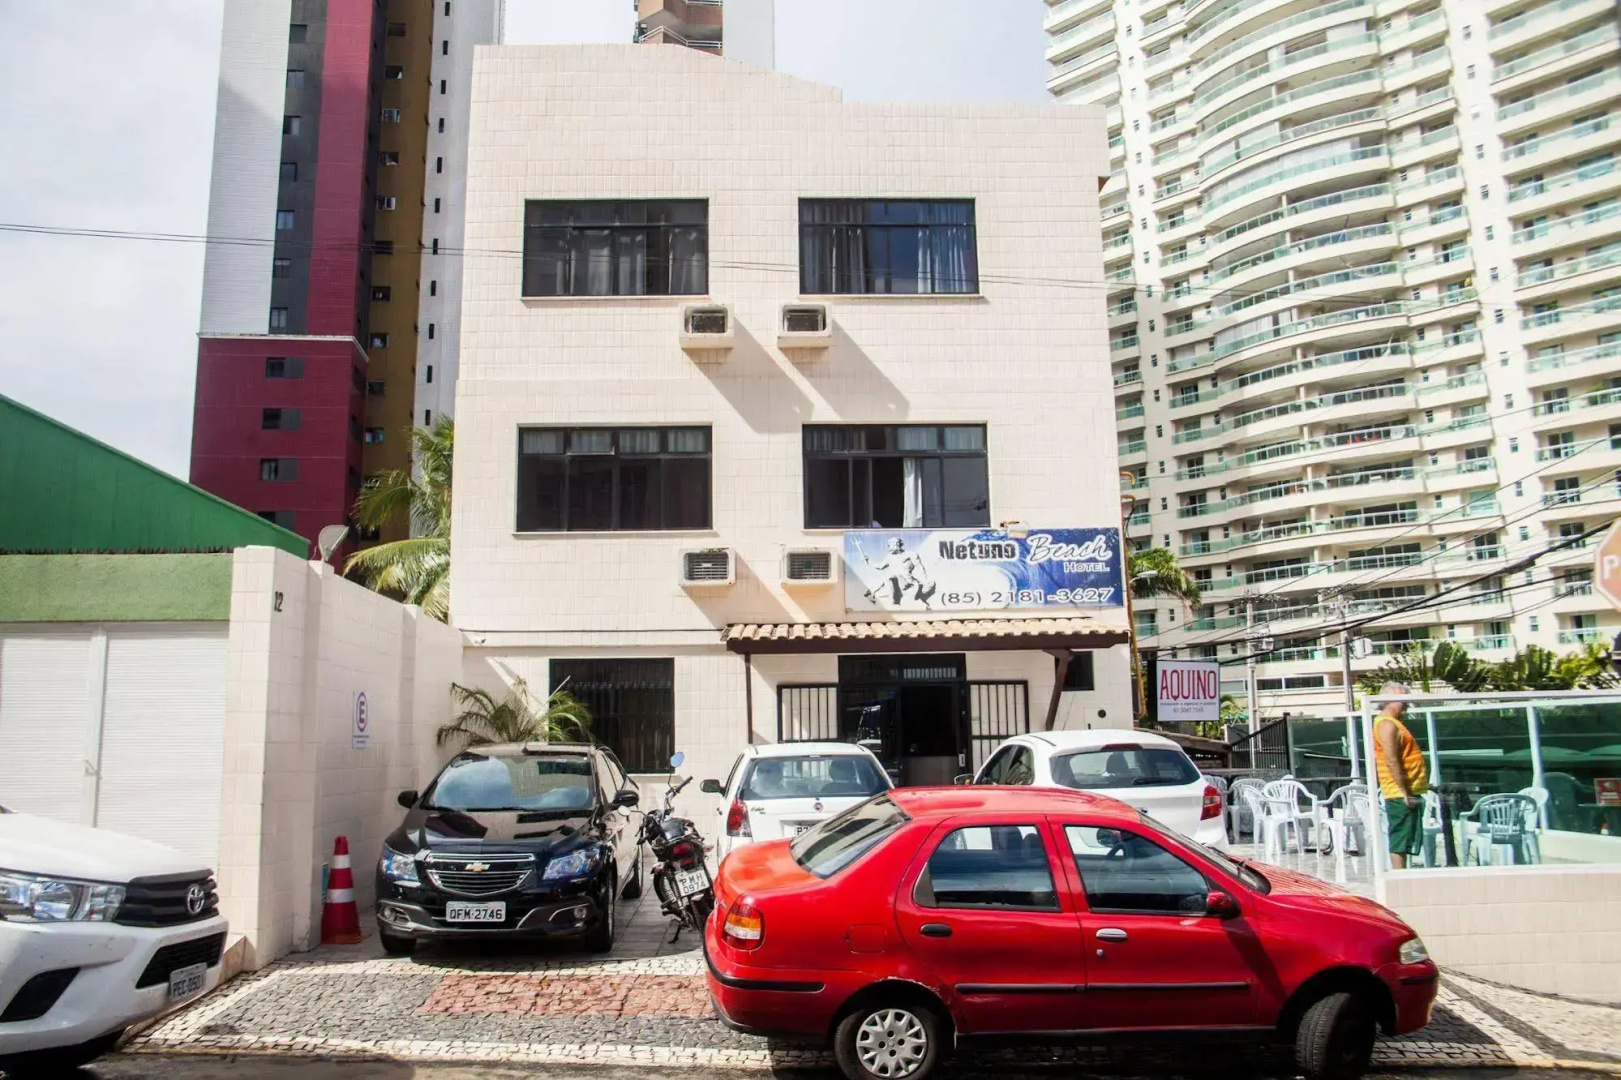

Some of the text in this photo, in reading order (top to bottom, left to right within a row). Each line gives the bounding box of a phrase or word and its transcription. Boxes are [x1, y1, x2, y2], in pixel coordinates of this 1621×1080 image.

[938, 535, 1109, 562] Netuno Beach
[1064, 562, 1110, 573] HOTEL
[273, 590, 284, 613] 12
[941, 588, 1115, 606] (85) 2181-3627
[1159, 669, 1217, 701] AQUINO
[359, 700, 366, 724] E
[682, 880, 706, 894] 0974
